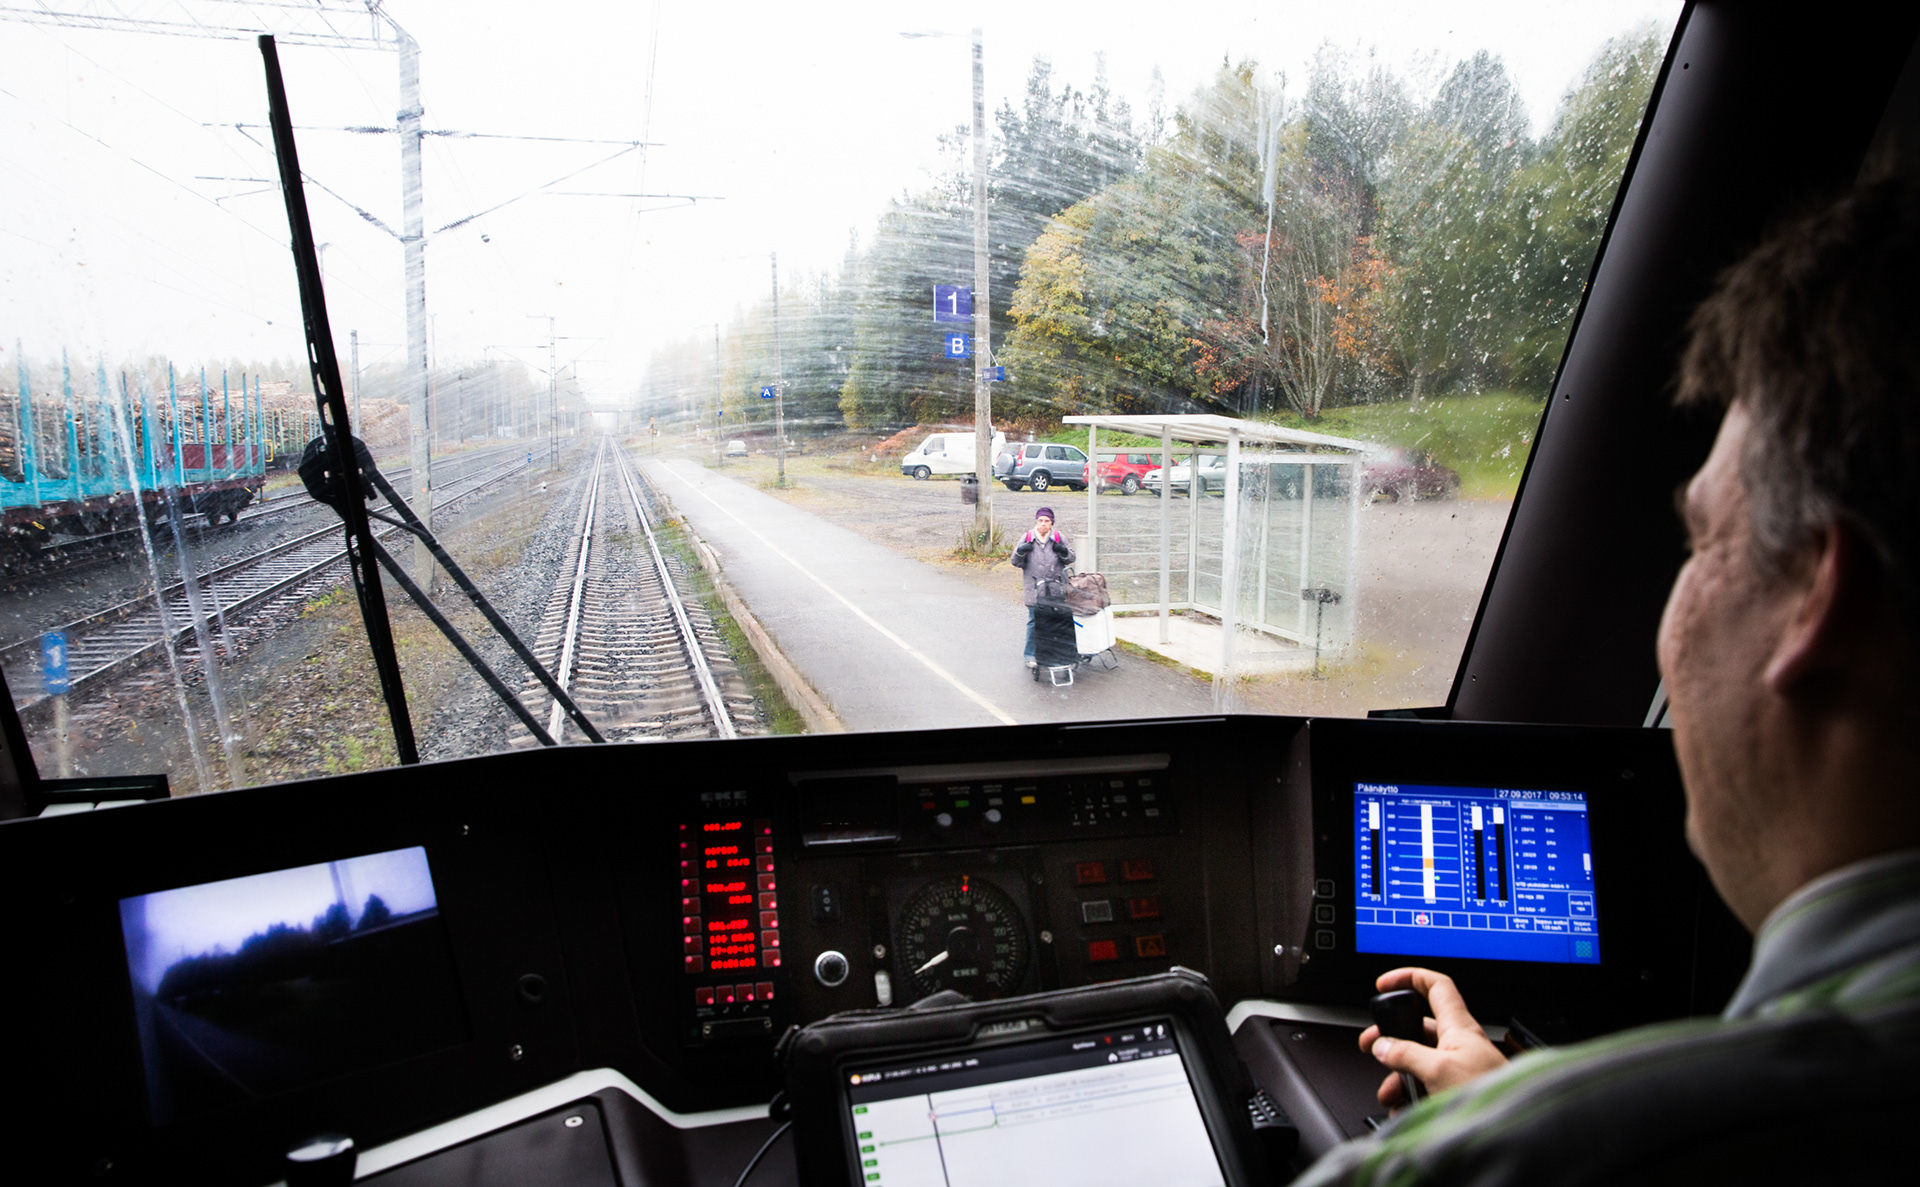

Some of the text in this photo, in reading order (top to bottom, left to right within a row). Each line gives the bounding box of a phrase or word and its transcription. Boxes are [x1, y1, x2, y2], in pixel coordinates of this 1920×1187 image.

[948, 292, 957, 315] 1
[952, 338, 964, 354] B
[764, 388, 771, 396] A
[46, 645, 62, 668] 1
[1358, 784, 1398, 794] Päänäyttö
[1499, 790, 1542, 799] 27.09.2017
[1549, 792, 1583, 801] 09:53:14
